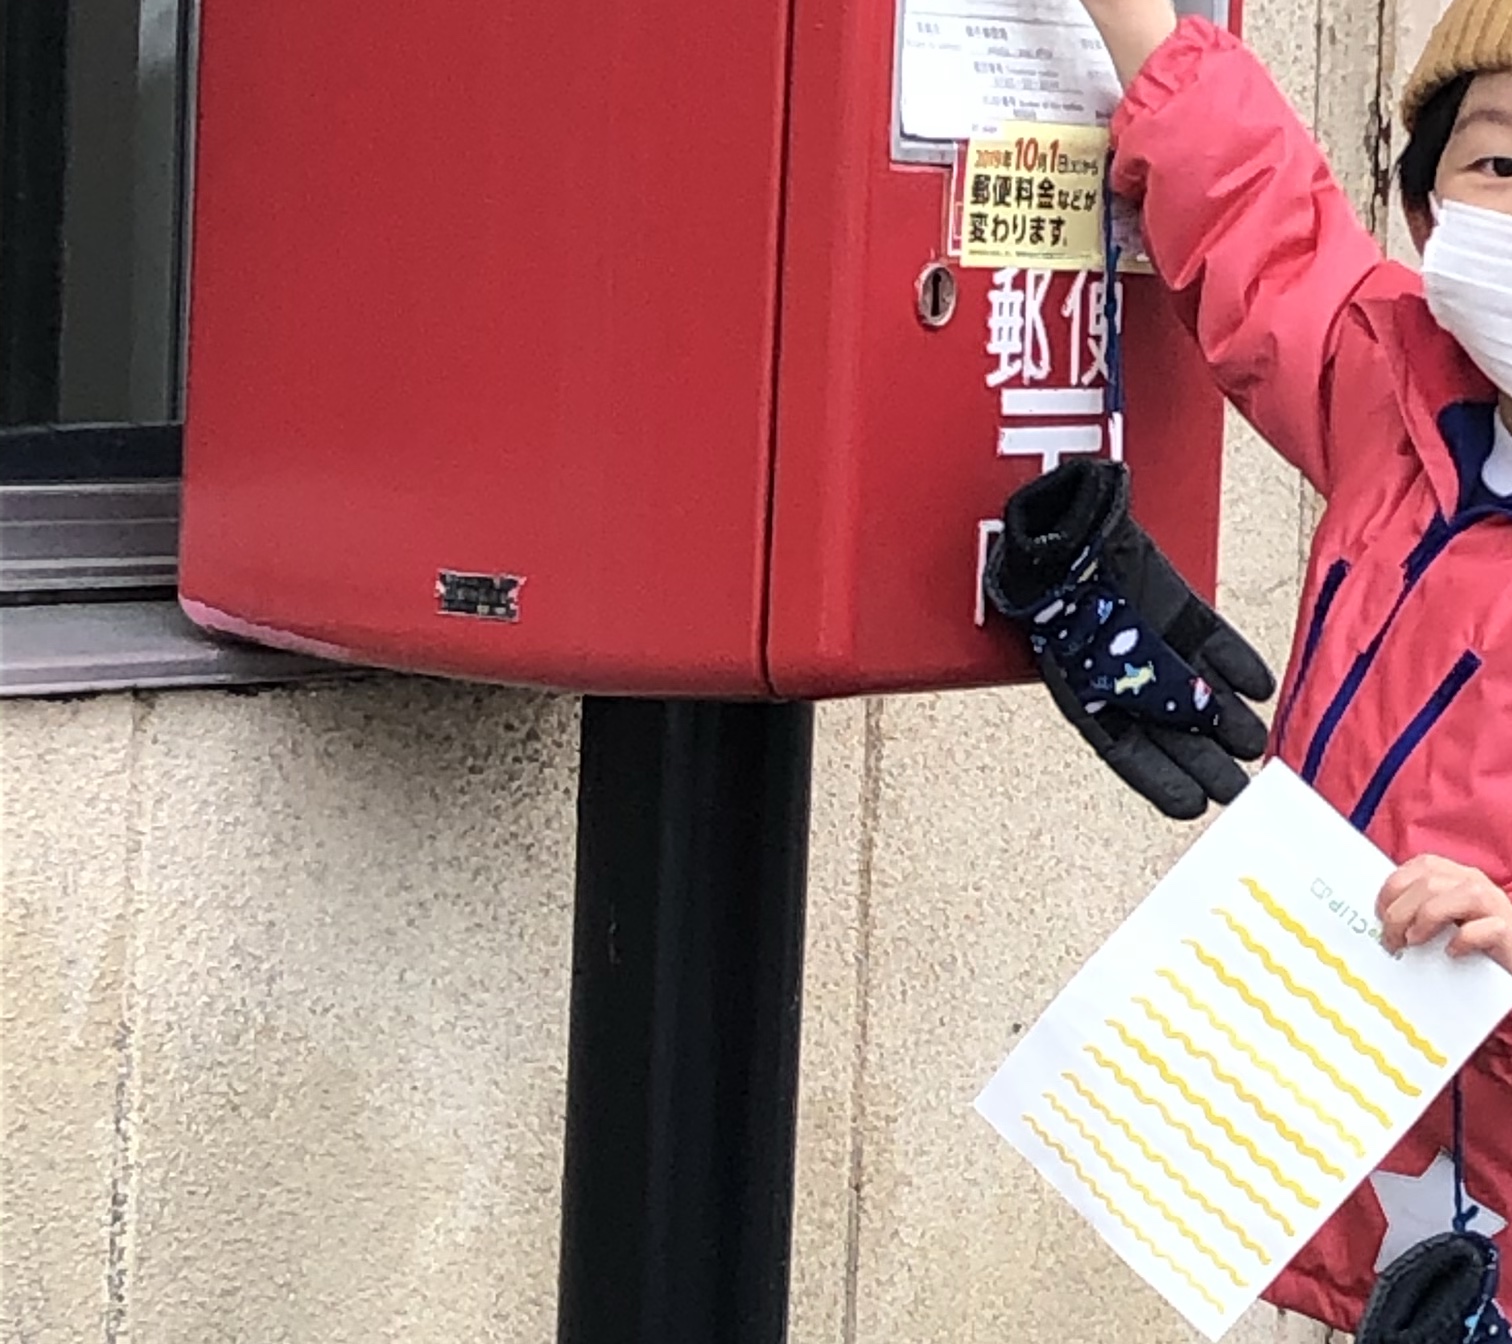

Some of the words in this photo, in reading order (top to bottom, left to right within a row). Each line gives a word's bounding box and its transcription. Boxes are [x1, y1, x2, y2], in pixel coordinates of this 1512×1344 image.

[970, 174, 1097, 211] 郵便料金などが
[985, 266, 1125, 387] 郵便
